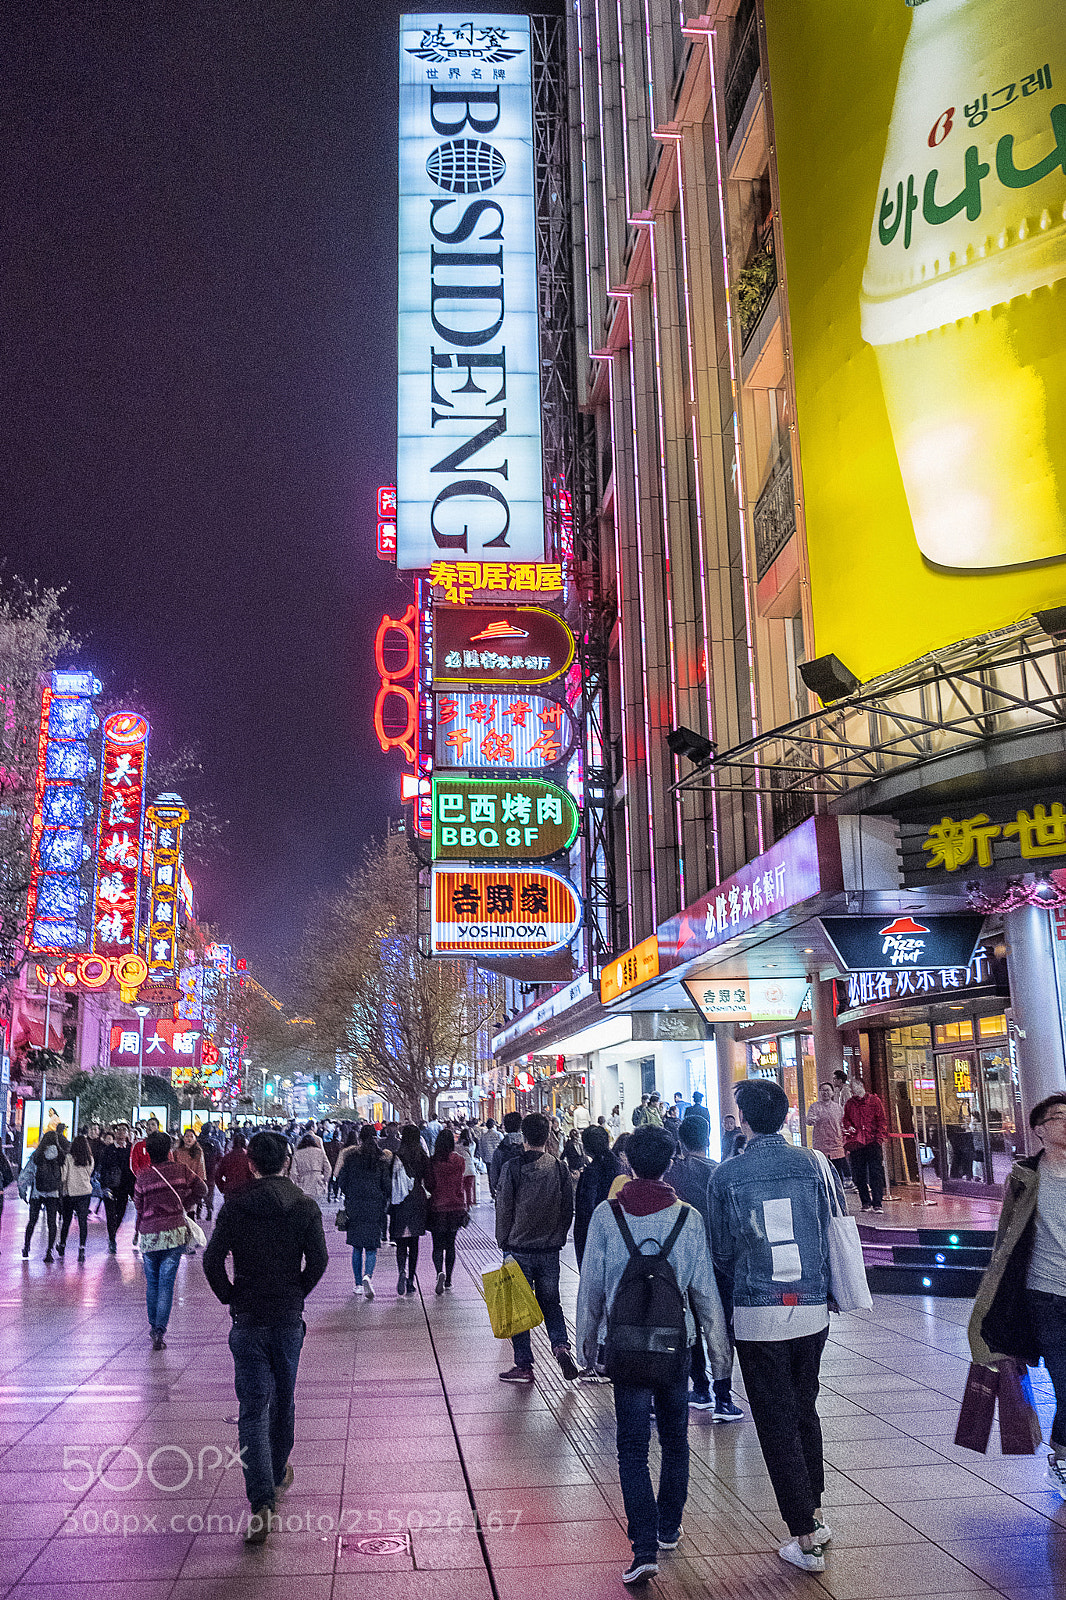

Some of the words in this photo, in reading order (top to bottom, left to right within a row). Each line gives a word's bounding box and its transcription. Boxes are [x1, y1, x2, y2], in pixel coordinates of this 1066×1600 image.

[420, 22, 510, 49] 波司登
[447, 49, 483, 58] BSD
[425, 67, 506, 80] 世界名牌
[964, 63, 1053, 128] 빙그레
[427, 85, 511, 554] BOSIDENG
[429, 561, 563, 591] 寿司居酒屋
[444, 586, 474, 604] 4F
[438, 792, 563, 826] 巴西烤肉
[441, 827, 500, 848] BBQ
[505, 826, 540, 848] 8F
[922, 801, 1066, 872] 新世
[451, 883, 549, 915] 吉野家
[704, 861, 787, 940] 必胜客欢乐餐厅
[882, 934, 926, 954] Pizza
[889, 949, 925, 966] Hut
[118, 1030, 194, 1055] 周大福
